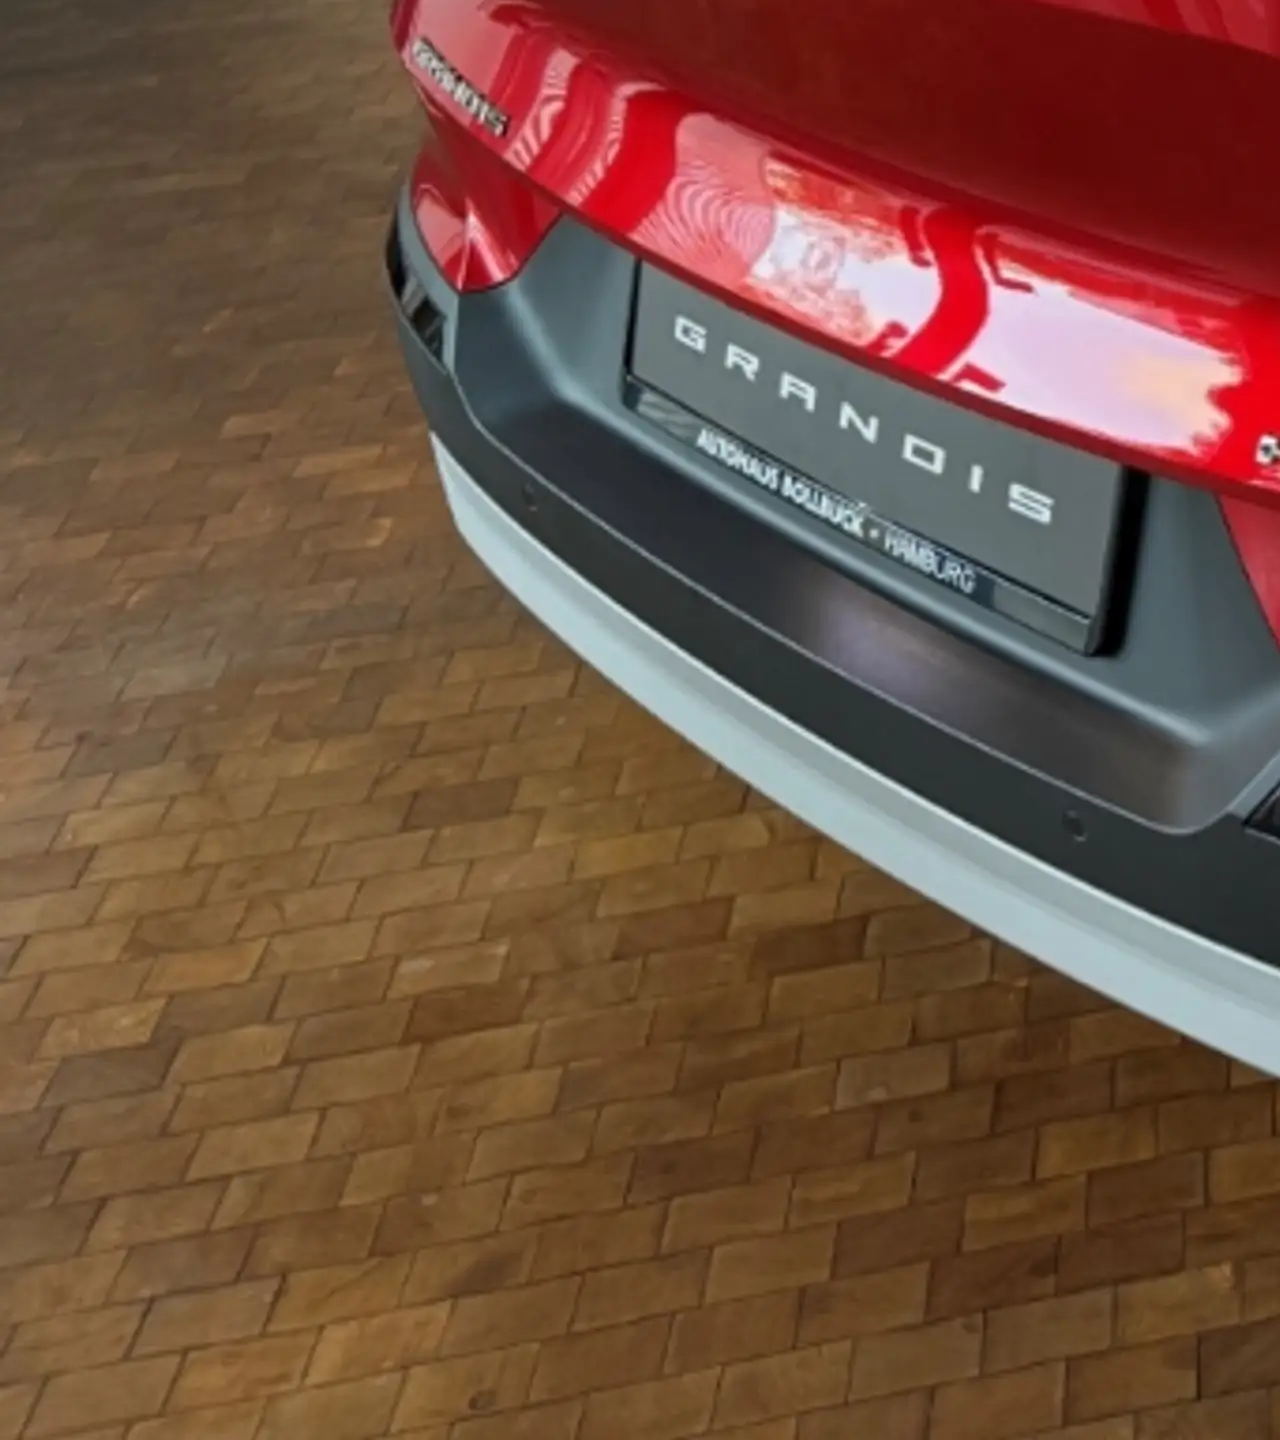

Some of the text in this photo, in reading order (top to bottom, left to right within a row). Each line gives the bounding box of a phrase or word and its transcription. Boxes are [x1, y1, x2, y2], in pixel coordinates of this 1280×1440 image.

[674, 315, 1055, 524] GRANDIS
[696, 428, 779, 490] AUTOHAUS
[781, 473, 866, 539] BOLLBUCK
[883, 528, 978, 595] HAMBURG
